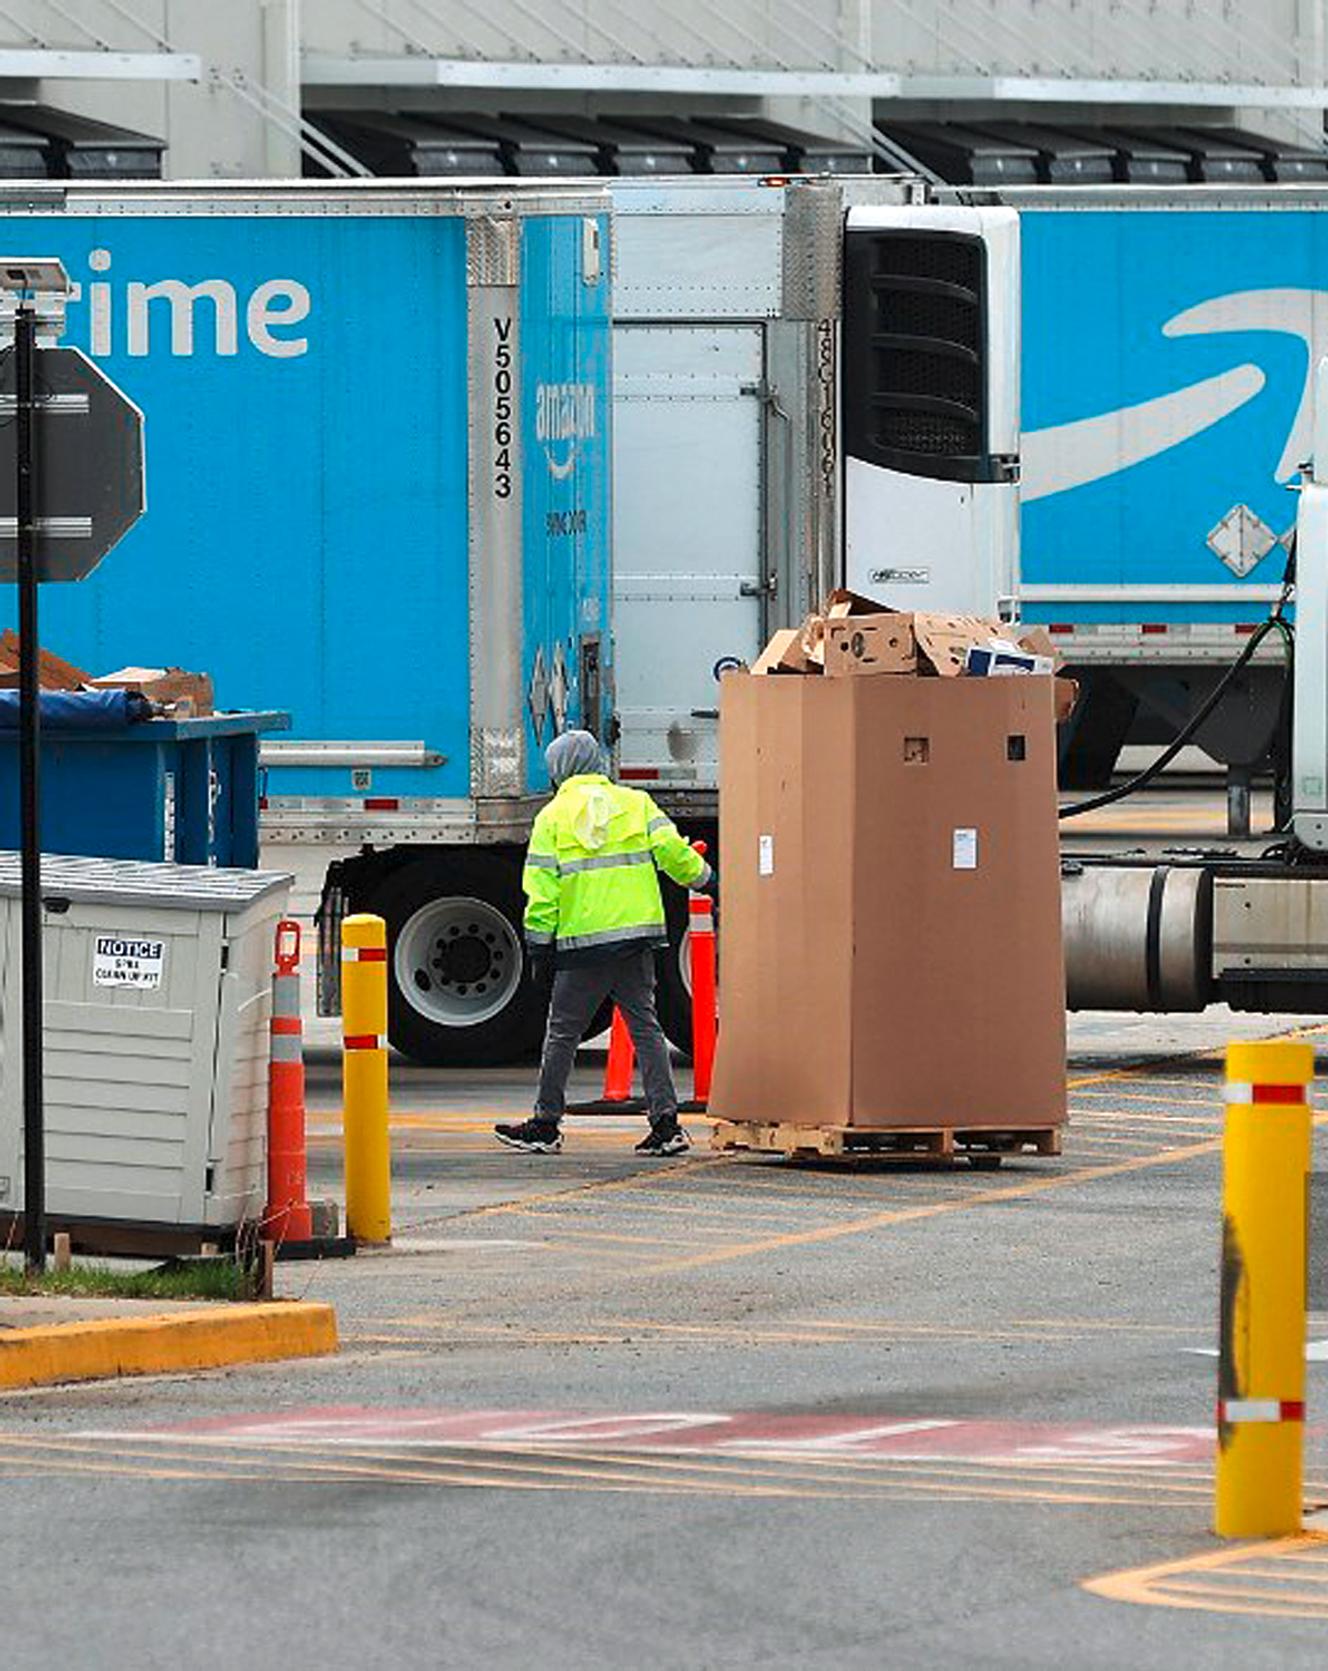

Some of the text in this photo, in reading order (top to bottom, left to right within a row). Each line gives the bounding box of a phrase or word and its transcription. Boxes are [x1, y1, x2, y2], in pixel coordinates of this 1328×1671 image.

[494, 317, 512, 498] V505643
[536, 383, 595, 441] amazon
[100, 940, 158, 957] NOTICE
